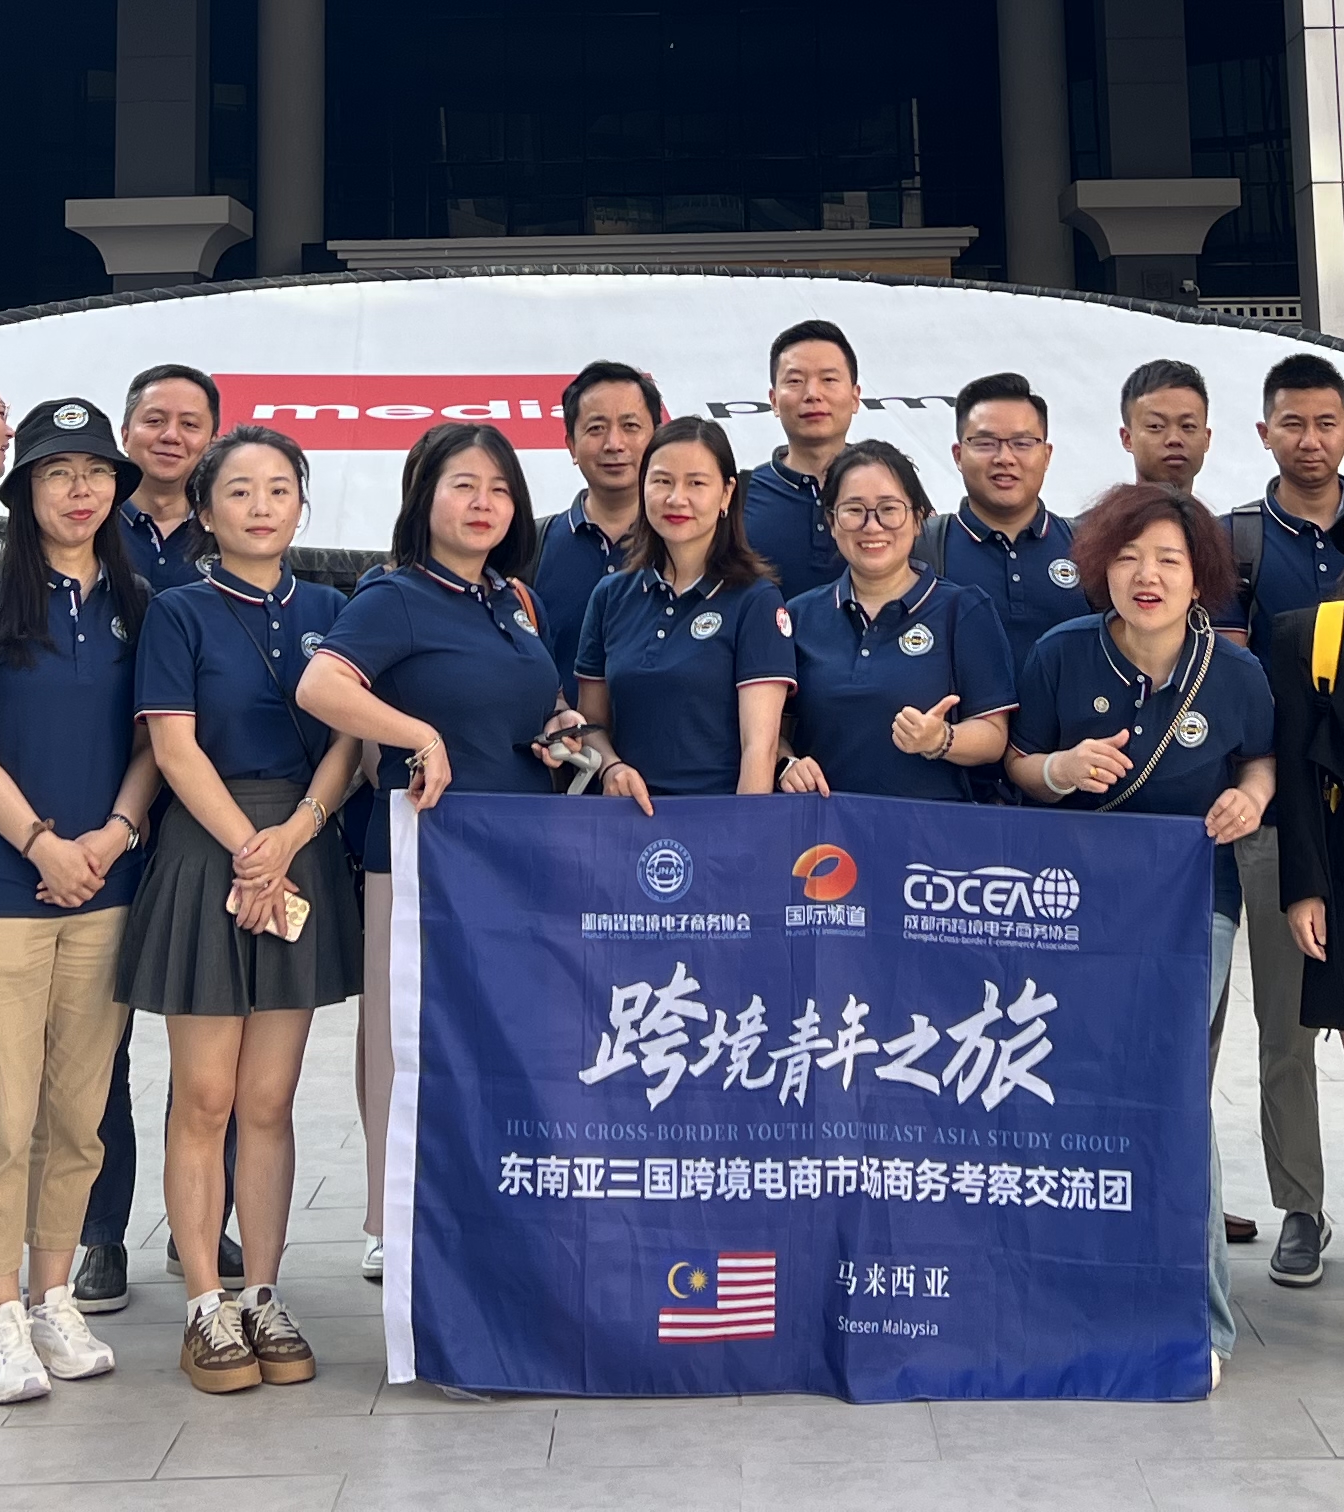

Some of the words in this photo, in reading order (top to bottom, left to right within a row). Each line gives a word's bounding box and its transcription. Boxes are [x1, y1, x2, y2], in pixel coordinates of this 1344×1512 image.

[253, 399, 565, 422] medi
[785, 904, 866, 927] 国际频道
[578, 961, 1058, 1112] 跨境青年之旅
[506, 1118, 577, 1140] HUNAN
[584, 1121, 739, 1142] CROSS-BORDER
[746, 1122, 814, 1140] YOUTH
[821, 1121, 927, 1144] SOUTHEAST
[933, 1126, 980, 1147] ASIA
[987, 1129, 1053, 1150] STUDY
[1060, 1133, 1130, 1153] GROUP
[498, 1151, 1132, 1211] 东南亚三国跨境电商市场商务考察交流团
[834, 1259, 950, 1298] 马来西亚
[837, 1315, 879, 1334] Stesen
[882, 1318, 939, 1339] Malaysia
